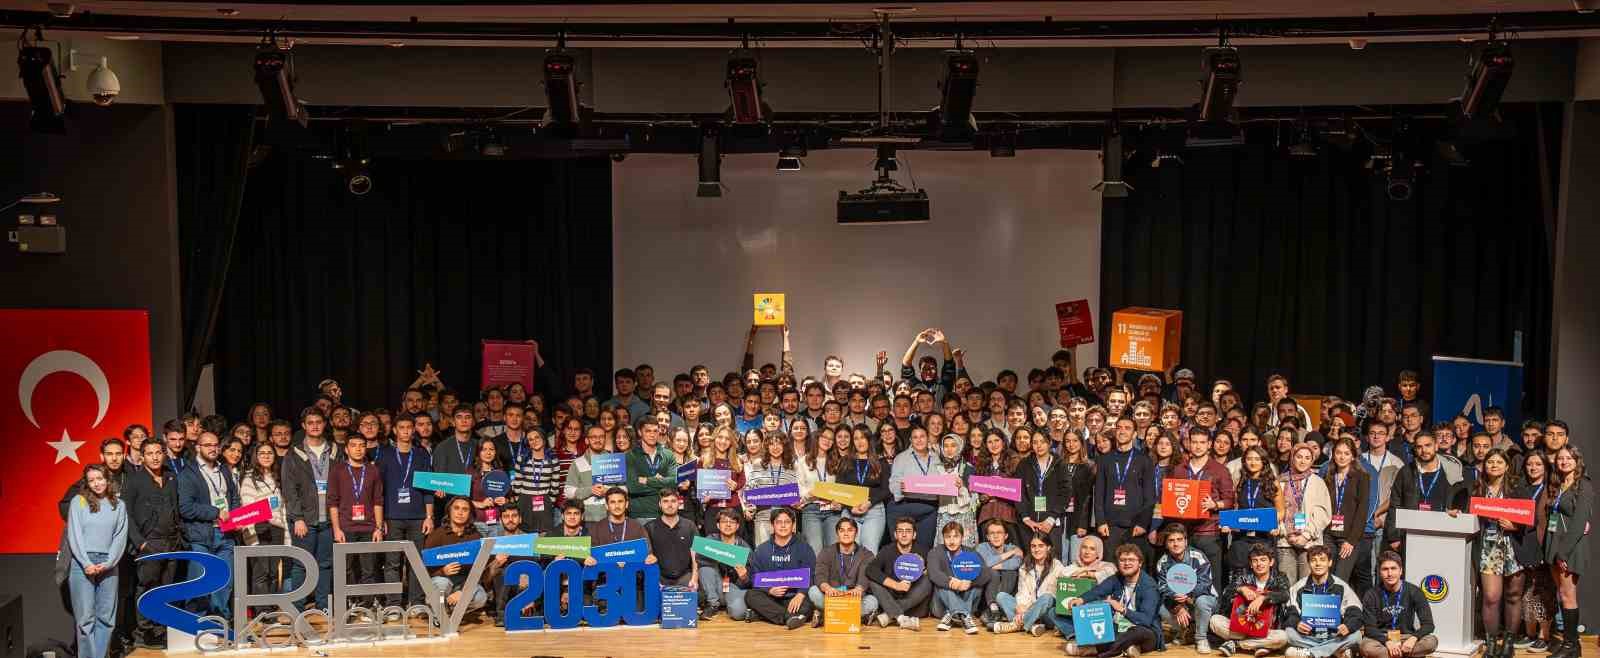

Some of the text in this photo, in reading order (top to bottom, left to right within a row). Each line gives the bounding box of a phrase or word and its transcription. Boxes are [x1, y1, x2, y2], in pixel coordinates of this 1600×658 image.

[1118, 322, 1127, 335] 11
[1059, 582, 1067, 591] 13
[503, 558, 662, 631] 2030
[1079, 608, 1086, 618] 6
